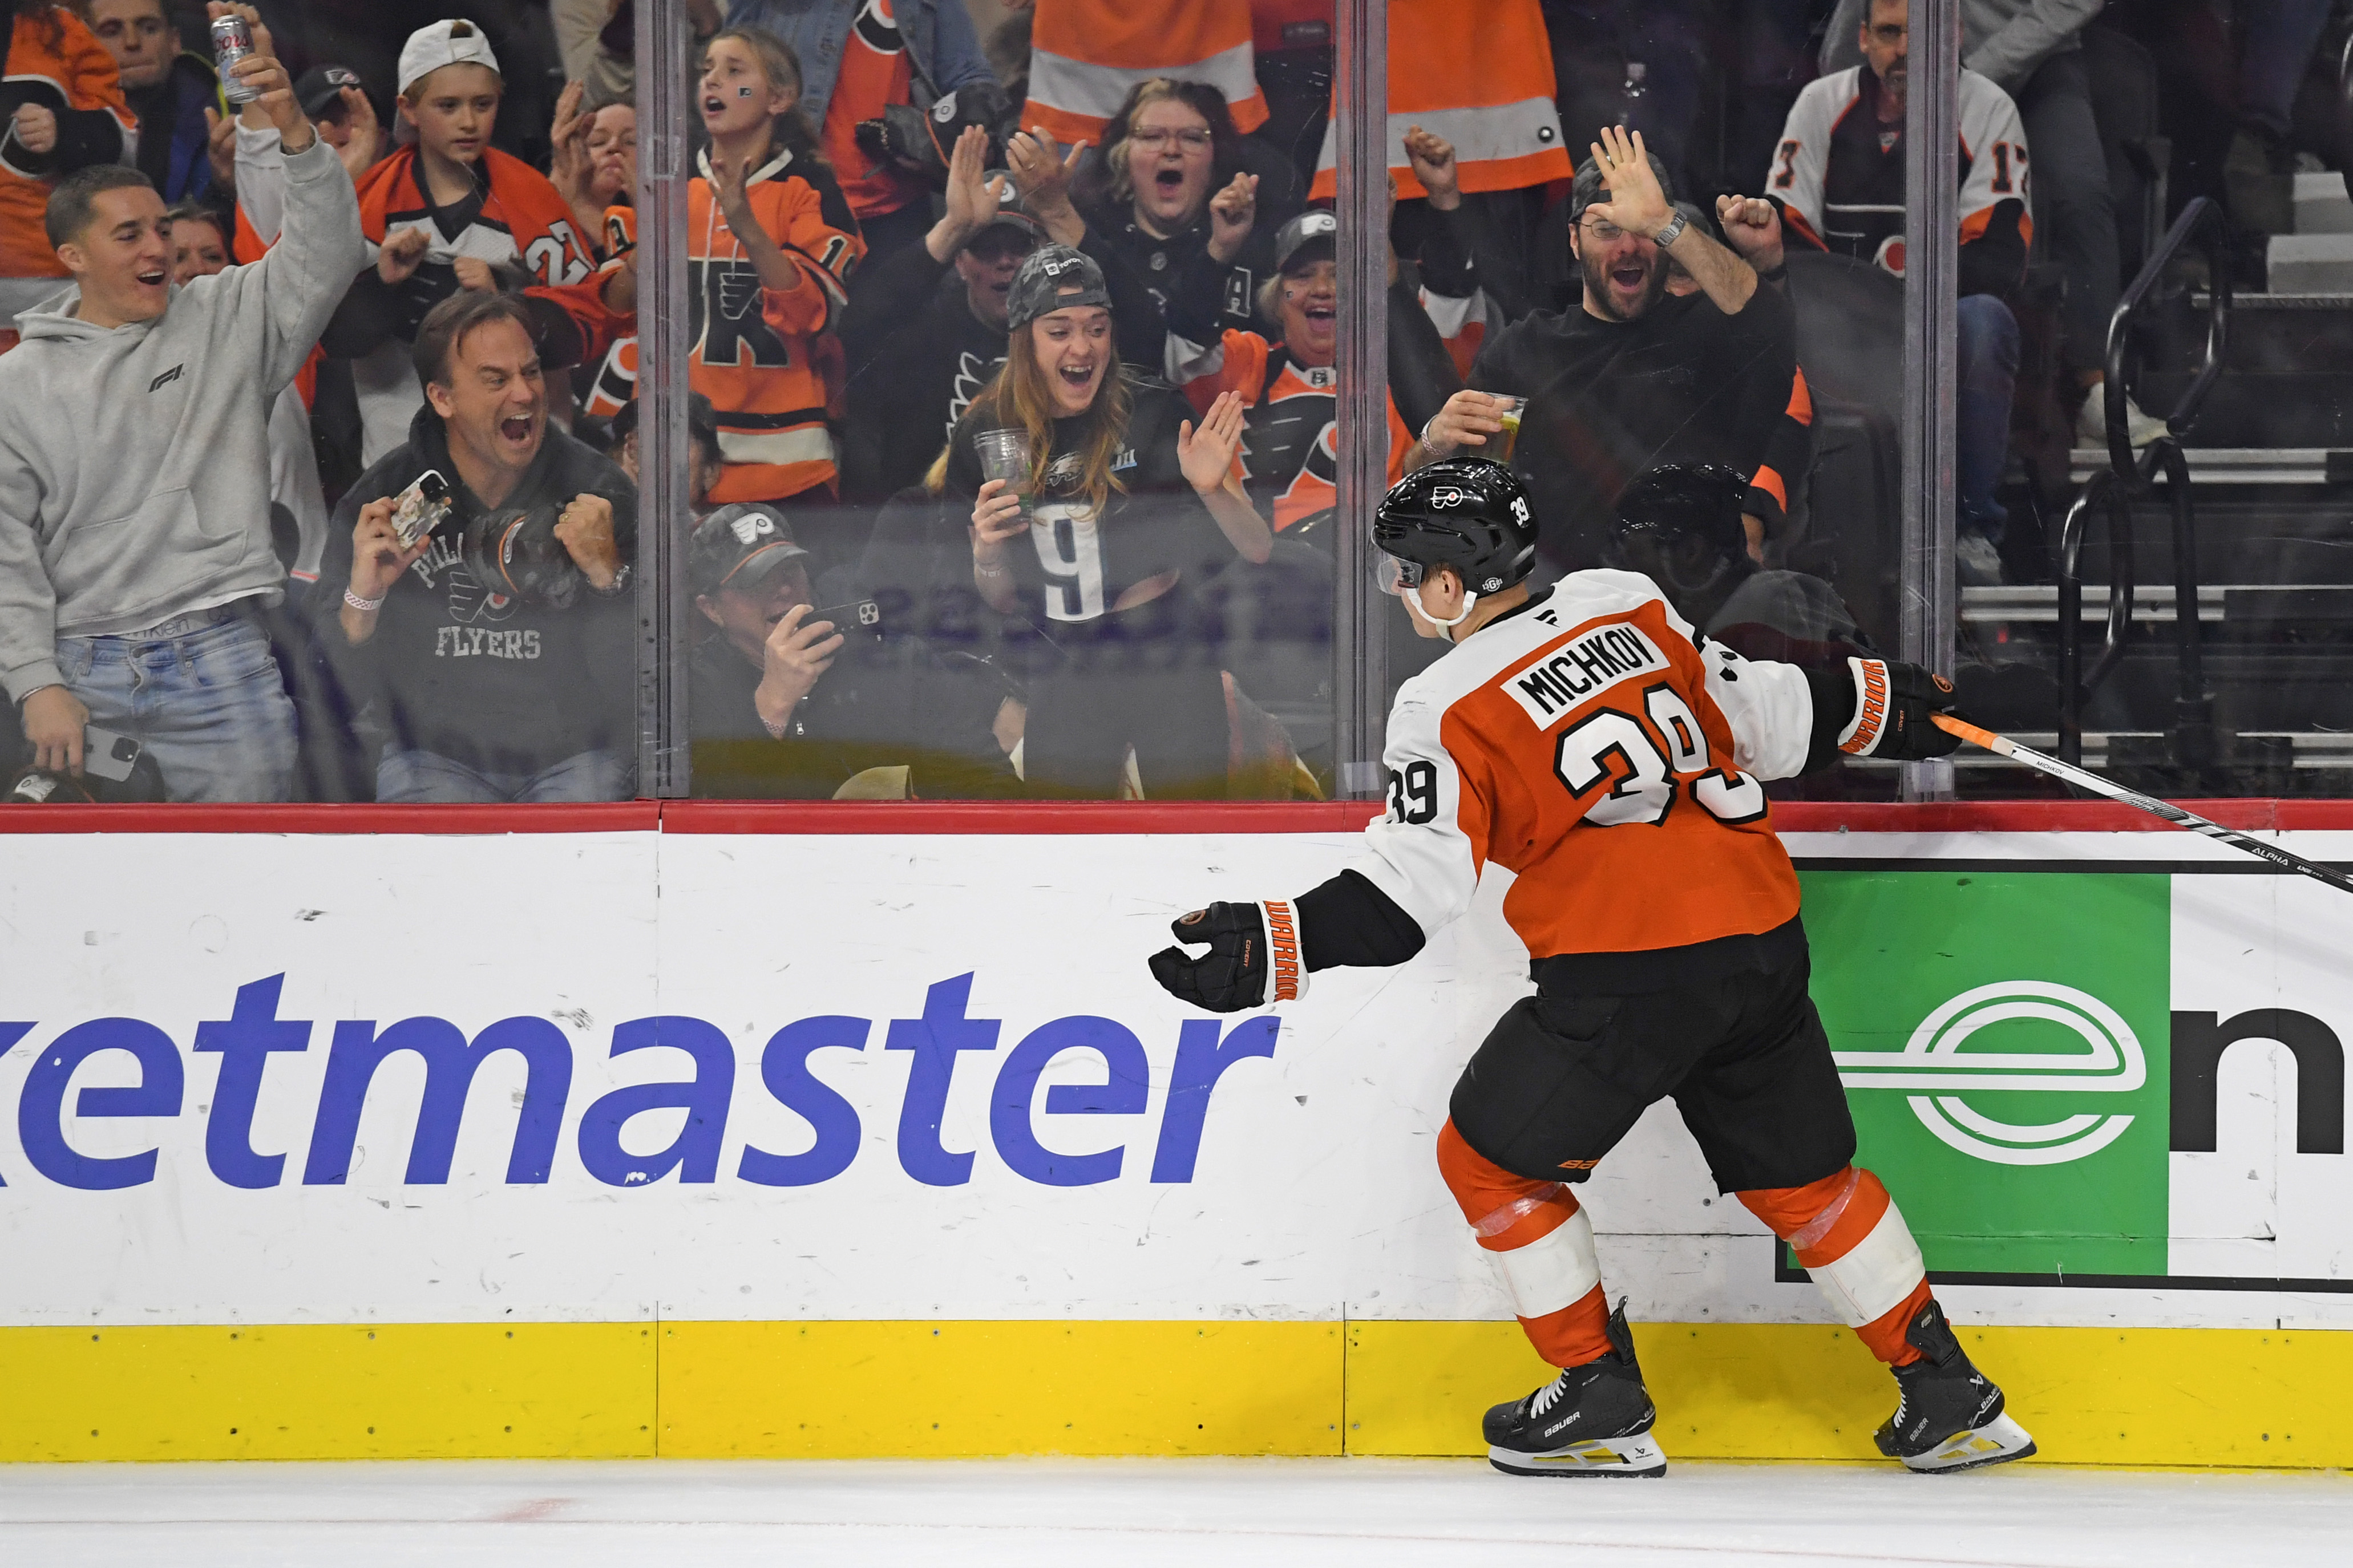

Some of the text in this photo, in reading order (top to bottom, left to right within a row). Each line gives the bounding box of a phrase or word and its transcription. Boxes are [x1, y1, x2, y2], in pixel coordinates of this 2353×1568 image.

[1510, 496, 1529, 527] 39
[1030, 504, 1107, 623] 9
[435, 626, 541, 659] FLYERS
[1517, 626, 1655, 715] MICHKOV
[1553, 680, 1768, 827] 39
[2036, 760, 2065, 775] MICHKOV
[2251, 847, 2289, 866] ALPHA
[1243, 939, 1252, 968] COVERT
[1263, 900, 1298, 1003] WARRIOR
[0, 971, 1281, 1190] etmaster
